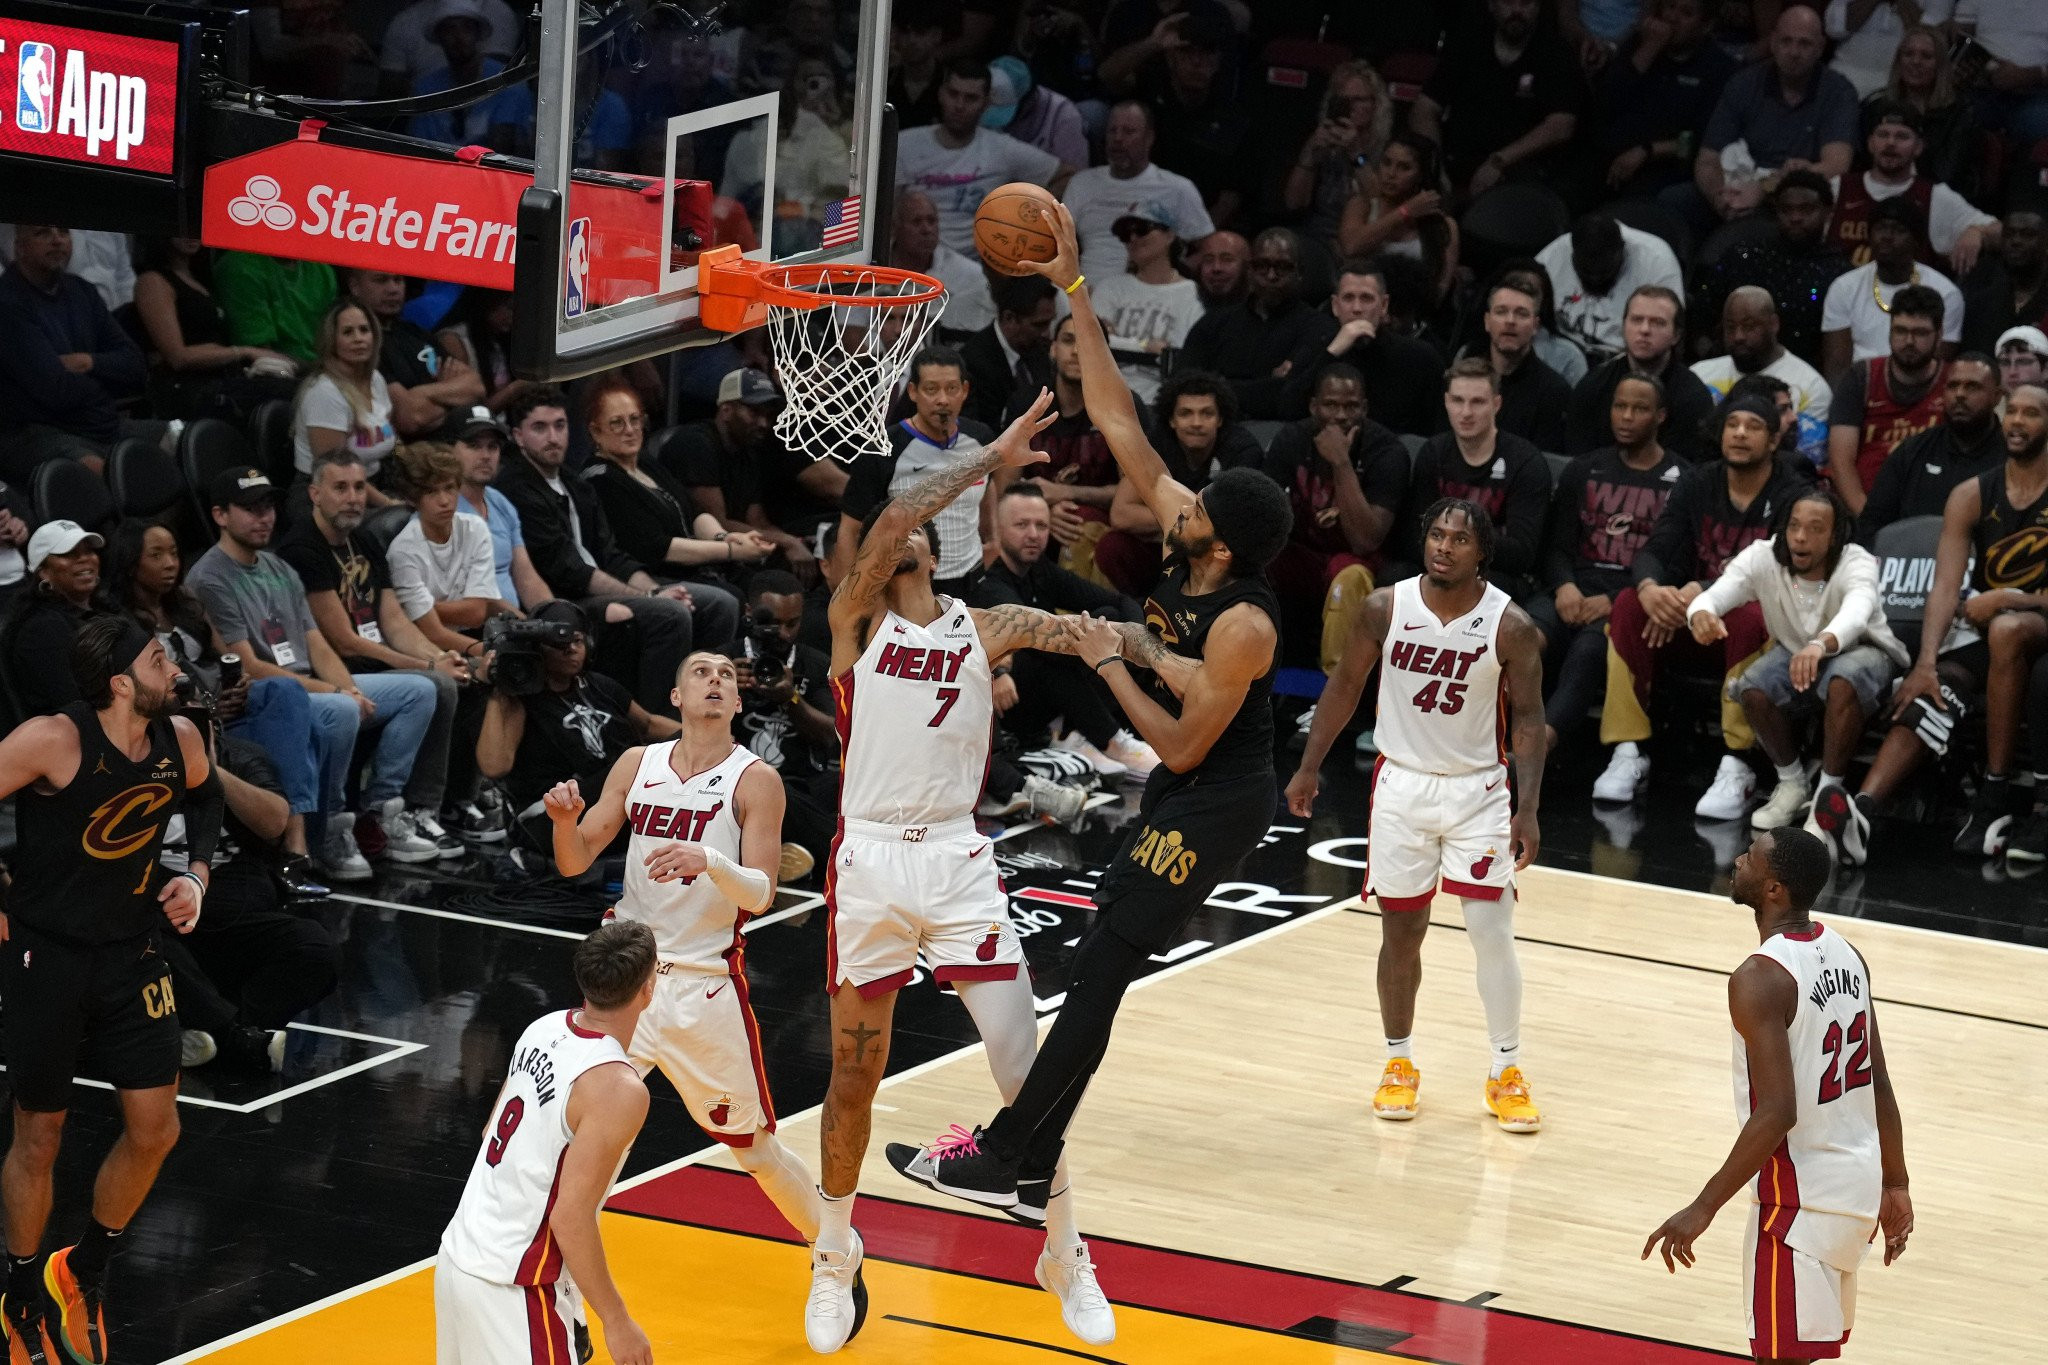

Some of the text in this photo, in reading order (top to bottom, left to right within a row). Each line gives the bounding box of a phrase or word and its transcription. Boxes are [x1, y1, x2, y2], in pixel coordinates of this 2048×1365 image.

[56, 48, 147, 161] App
[1174, 612, 1191, 636] CLIFFS
[875, 641, 973, 683] HEAT
[1390, 640, 1489, 681] HEAT
[926, 687, 961, 728] 7
[1412, 679, 1469, 716] 45
[151, 770, 178, 780] CLIFFS
[630, 799, 724, 842] HEAT
[132, 858, 154, 895] 1
[510, 1047, 555, 1108] LARSSON
[1817, 1009, 1872, 1106] 22
[485, 1094, 525, 1169] 9
